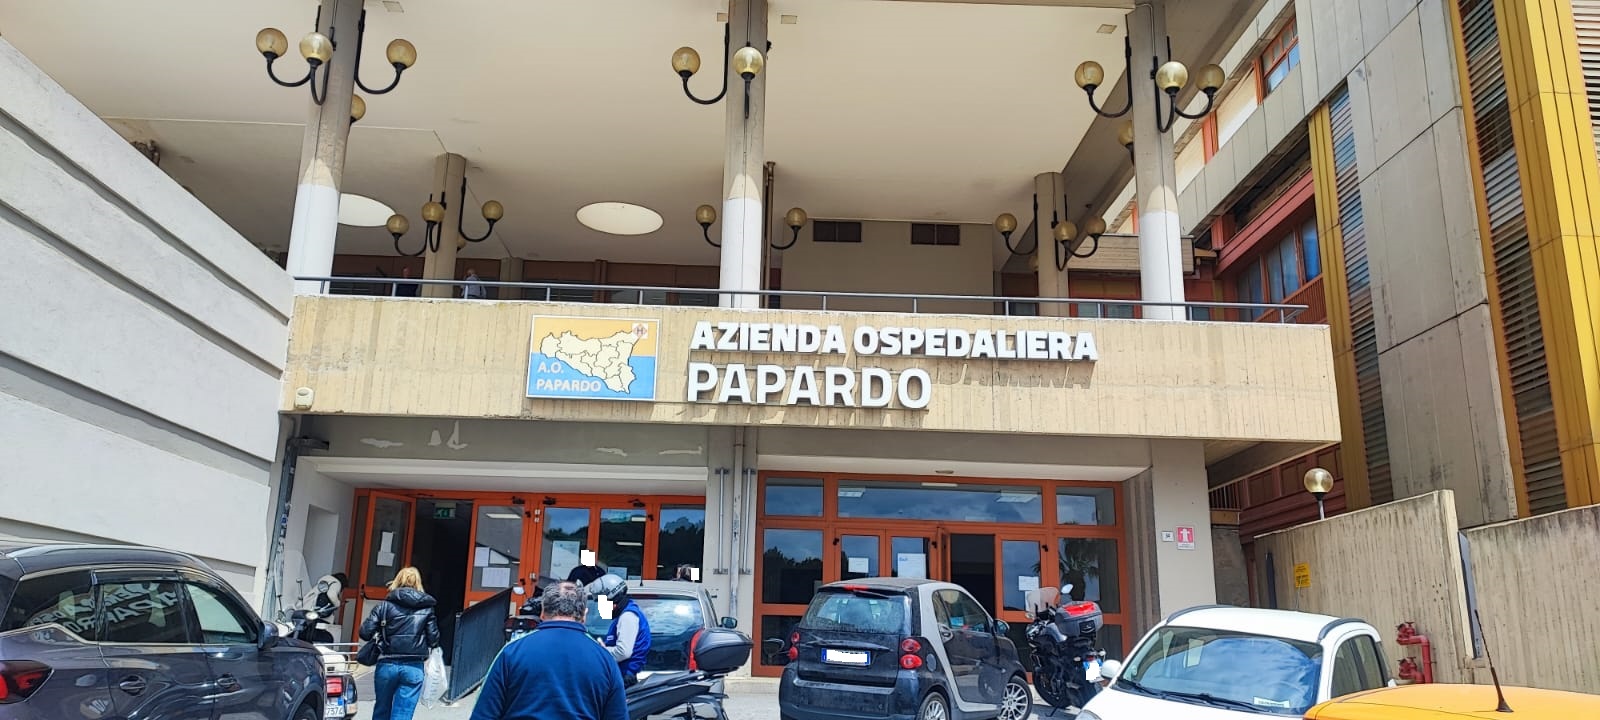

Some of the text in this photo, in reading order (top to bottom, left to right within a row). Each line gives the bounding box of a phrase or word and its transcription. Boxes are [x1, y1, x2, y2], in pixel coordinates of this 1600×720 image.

[690, 320, 1099, 361] AZIENDA OSPEDALIERA
[537, 361, 564, 374] A.O.
[536, 378, 602, 393] PAPARDO
[687, 361, 932, 410] PAPARDO
